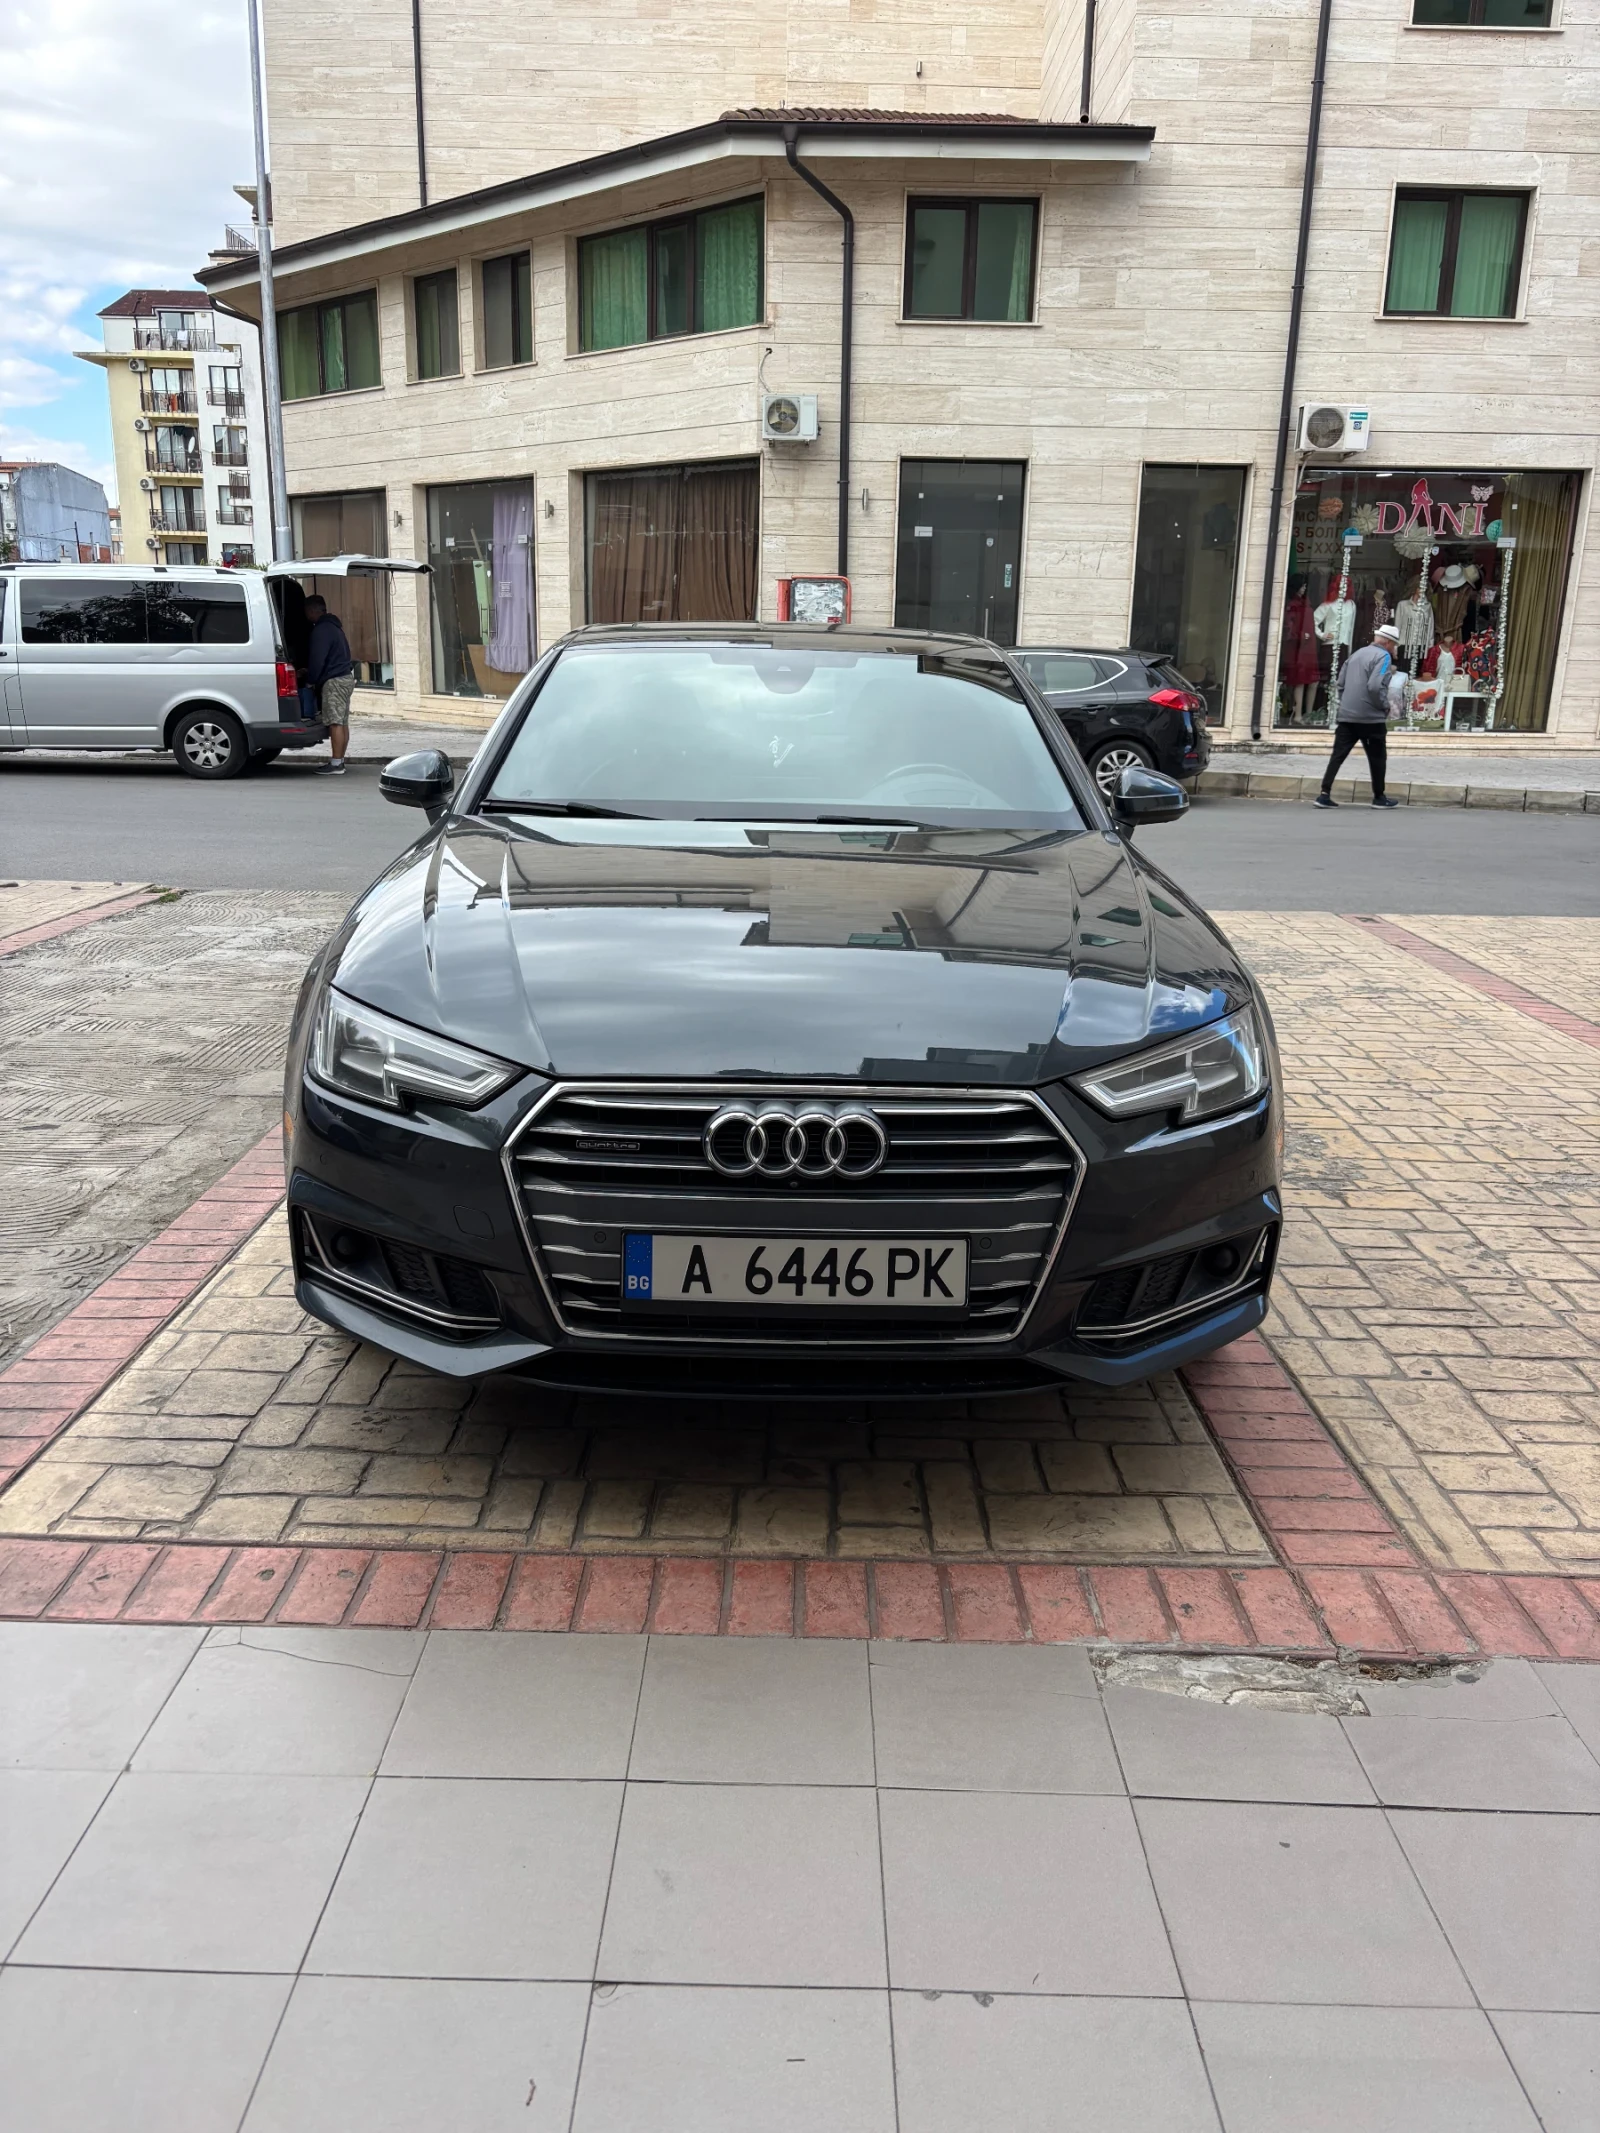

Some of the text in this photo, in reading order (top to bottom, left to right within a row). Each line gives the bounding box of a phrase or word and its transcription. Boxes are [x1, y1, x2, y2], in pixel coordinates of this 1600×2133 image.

[627, 1274, 650, 1291] BG
[681, 1244, 955, 1298] A 6446 PK
